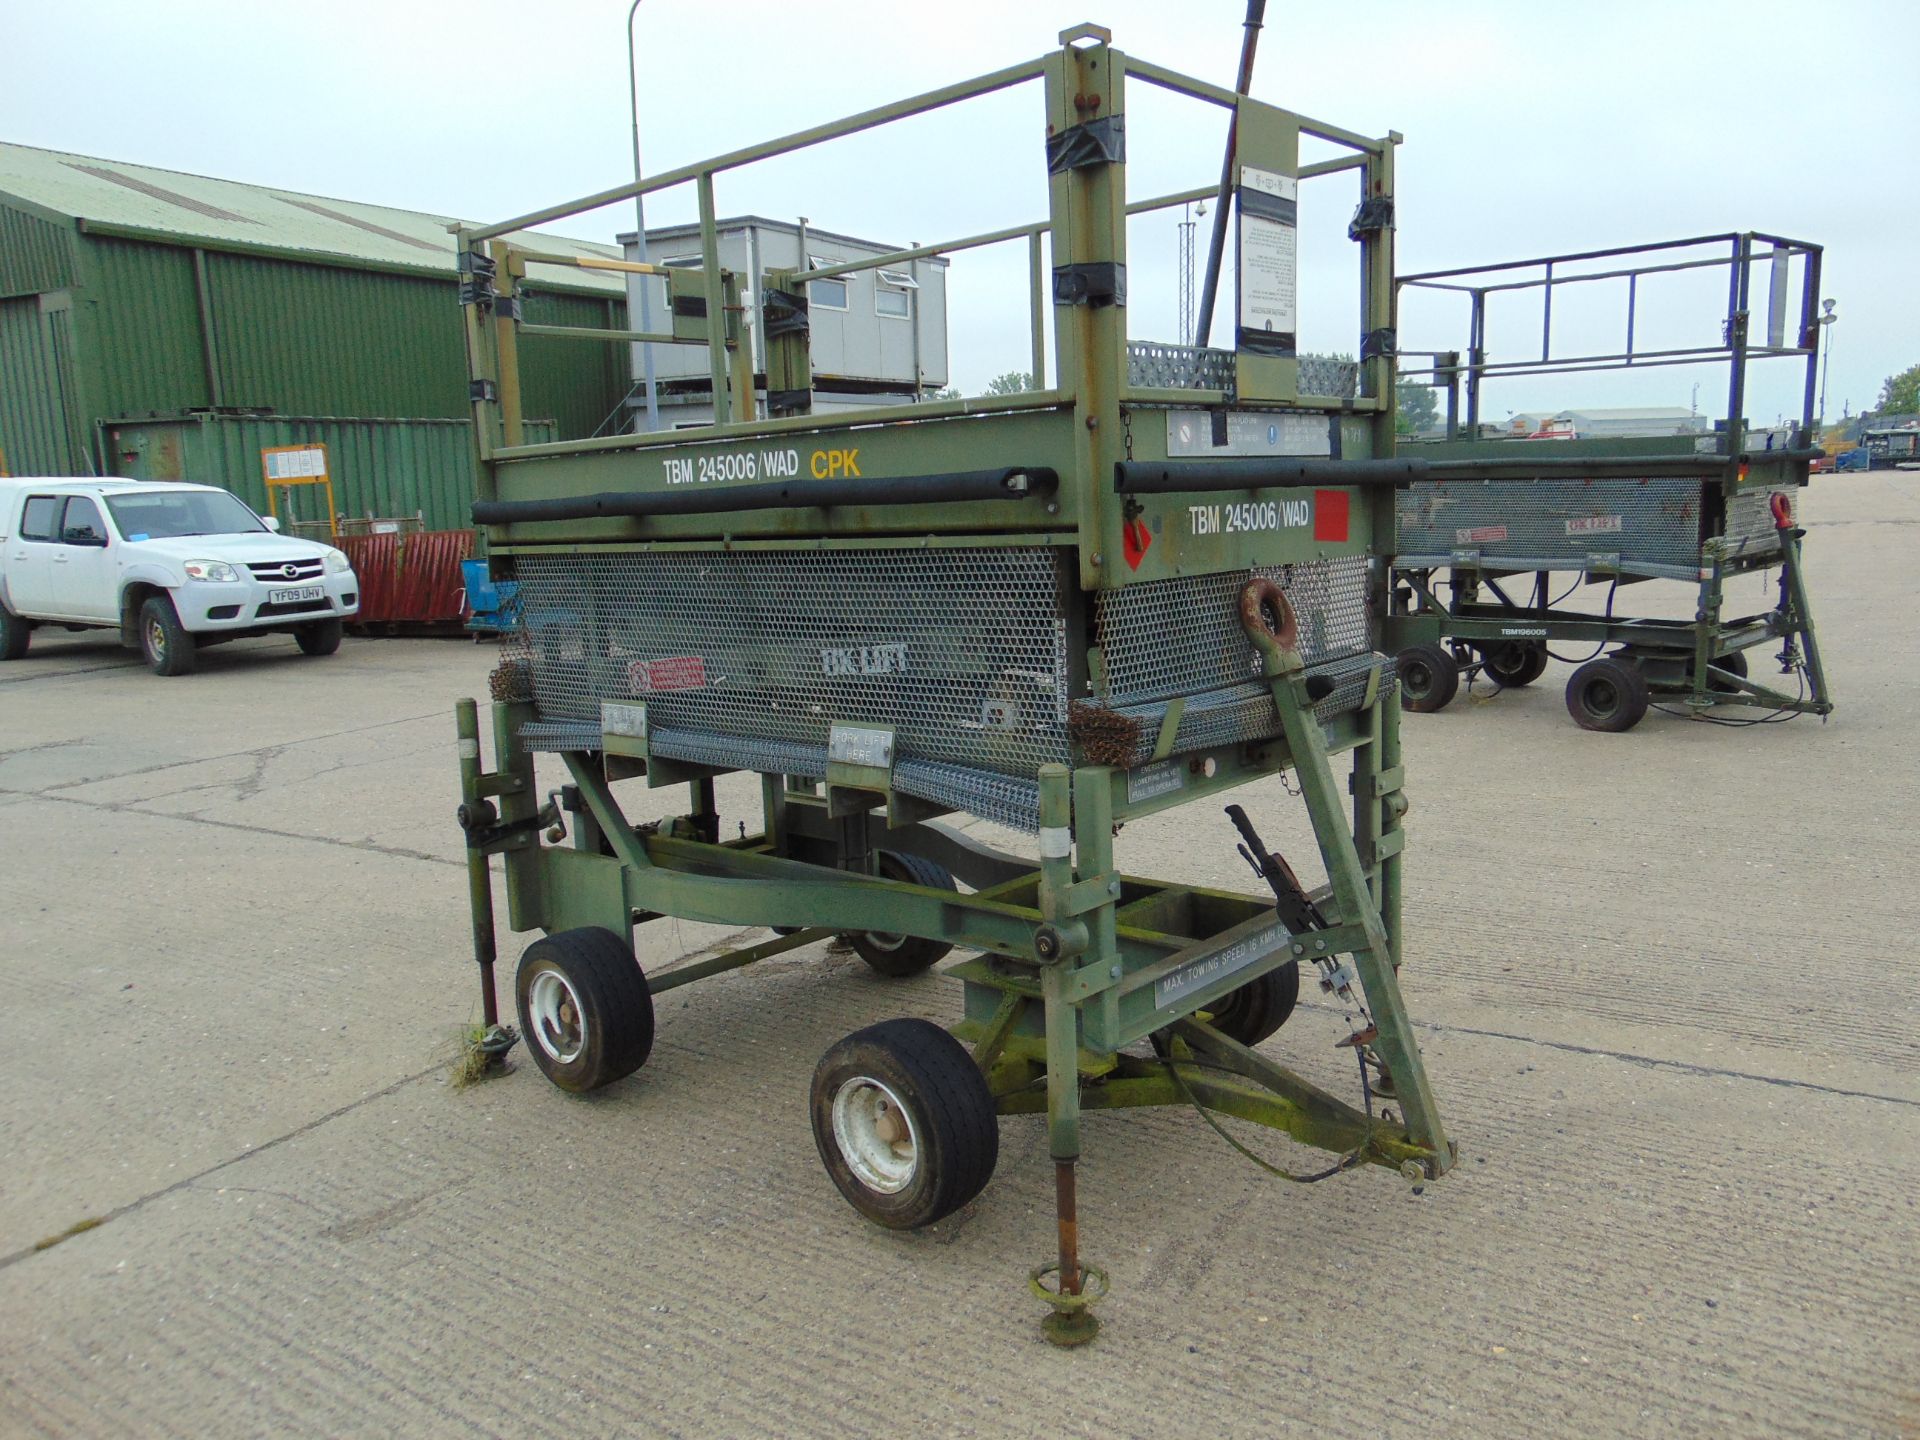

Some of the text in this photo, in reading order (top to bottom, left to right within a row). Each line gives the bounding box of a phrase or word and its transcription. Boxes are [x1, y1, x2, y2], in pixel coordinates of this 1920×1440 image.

[663, 448, 861, 484] TBM 245006/WAD CPK
[1188, 498, 1309, 535] TBM 245006/WAD
[274, 587, 320, 602] YF09 UHV
[1500, 628, 1548, 636] TBM196005
[836, 732, 886, 746] FORK LIFT
[846, 749, 872, 761] HERE
[1163, 974, 1185, 994] MAX.
[1187, 956, 1219, 981] TOWING
[1221, 943, 1247, 966] SPEED
[1248, 938, 1258, 952] 16
[1260, 930, 1275, 946] KMH
